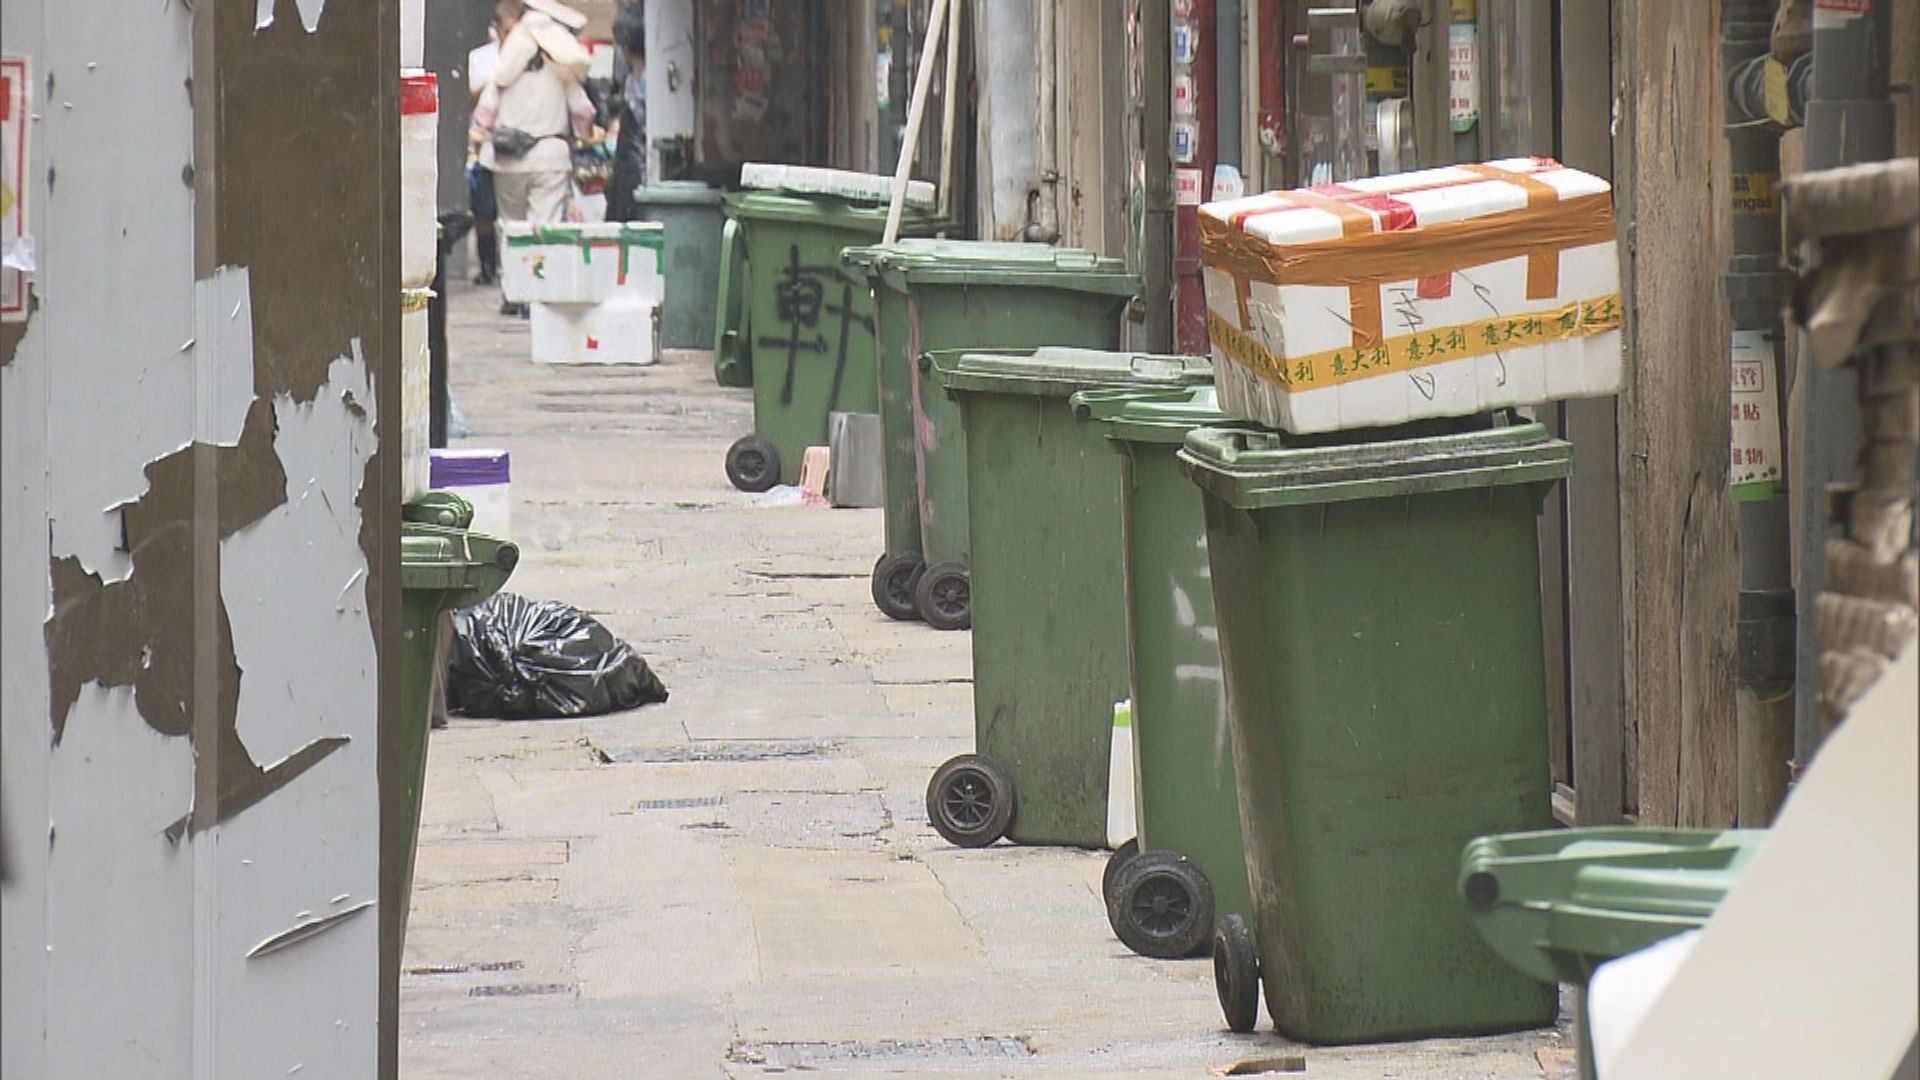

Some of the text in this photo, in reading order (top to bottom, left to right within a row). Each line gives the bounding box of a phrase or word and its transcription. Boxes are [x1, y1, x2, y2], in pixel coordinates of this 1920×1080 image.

[1330, 344, 1391, 377] 意大利
[1405, 329, 1467, 361] 意大利
[1481, 316, 1543, 346] 意大利
